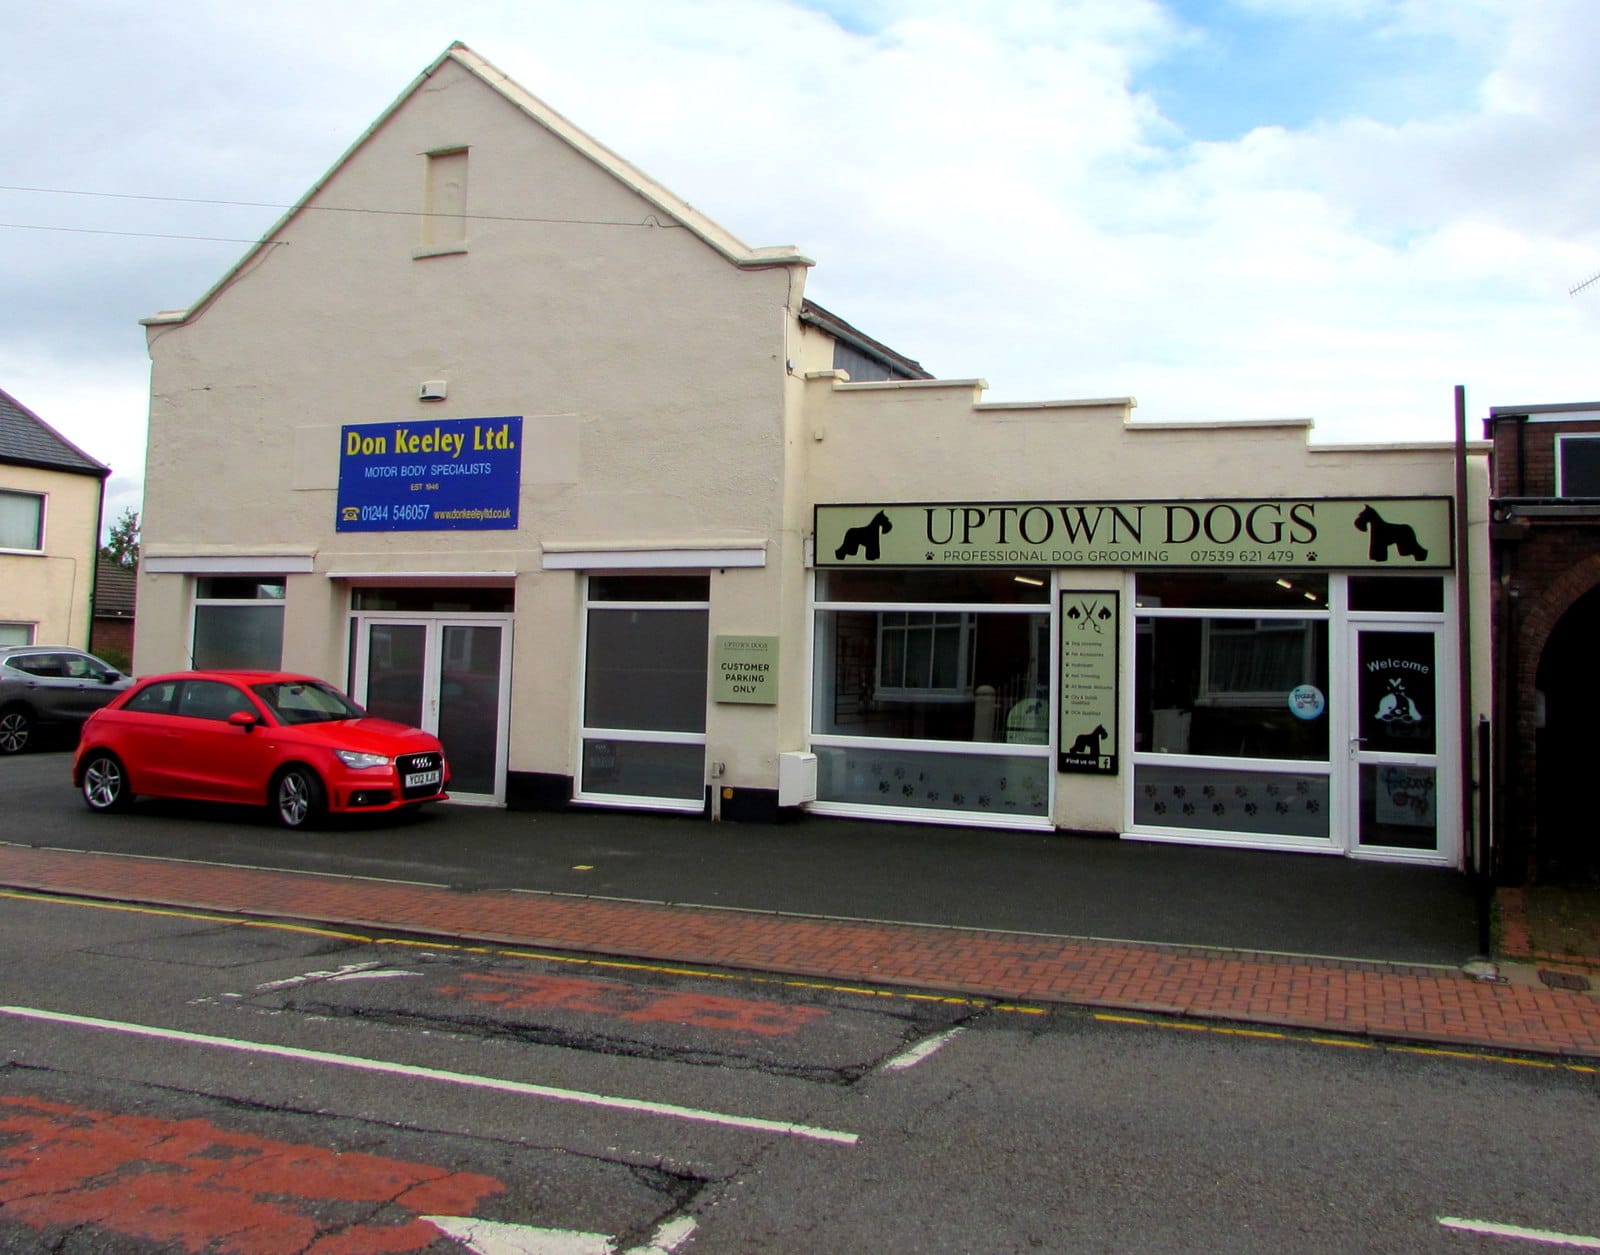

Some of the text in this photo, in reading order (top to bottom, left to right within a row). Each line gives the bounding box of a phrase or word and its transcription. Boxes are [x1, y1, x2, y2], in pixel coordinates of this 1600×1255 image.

[346, 424, 515, 458] Don Keeley Ltd.
[364, 463, 492, 478] MOTOR BODY SPECIALISTS
[361, 505, 388, 521] 01244
[393, 504, 430, 520] 546057
[924, 503, 1318, 545] UPTOWN DOGS
[943, 550, 1294, 562] PROFESSIONAL DOG GROOMING 07539 621 479
[721, 662, 770, 672] CUSTOMER
[1366, 658, 1430, 674] Welcome
[725, 673, 765, 683] PARKING
[732, 685, 757, 694] ONLY
